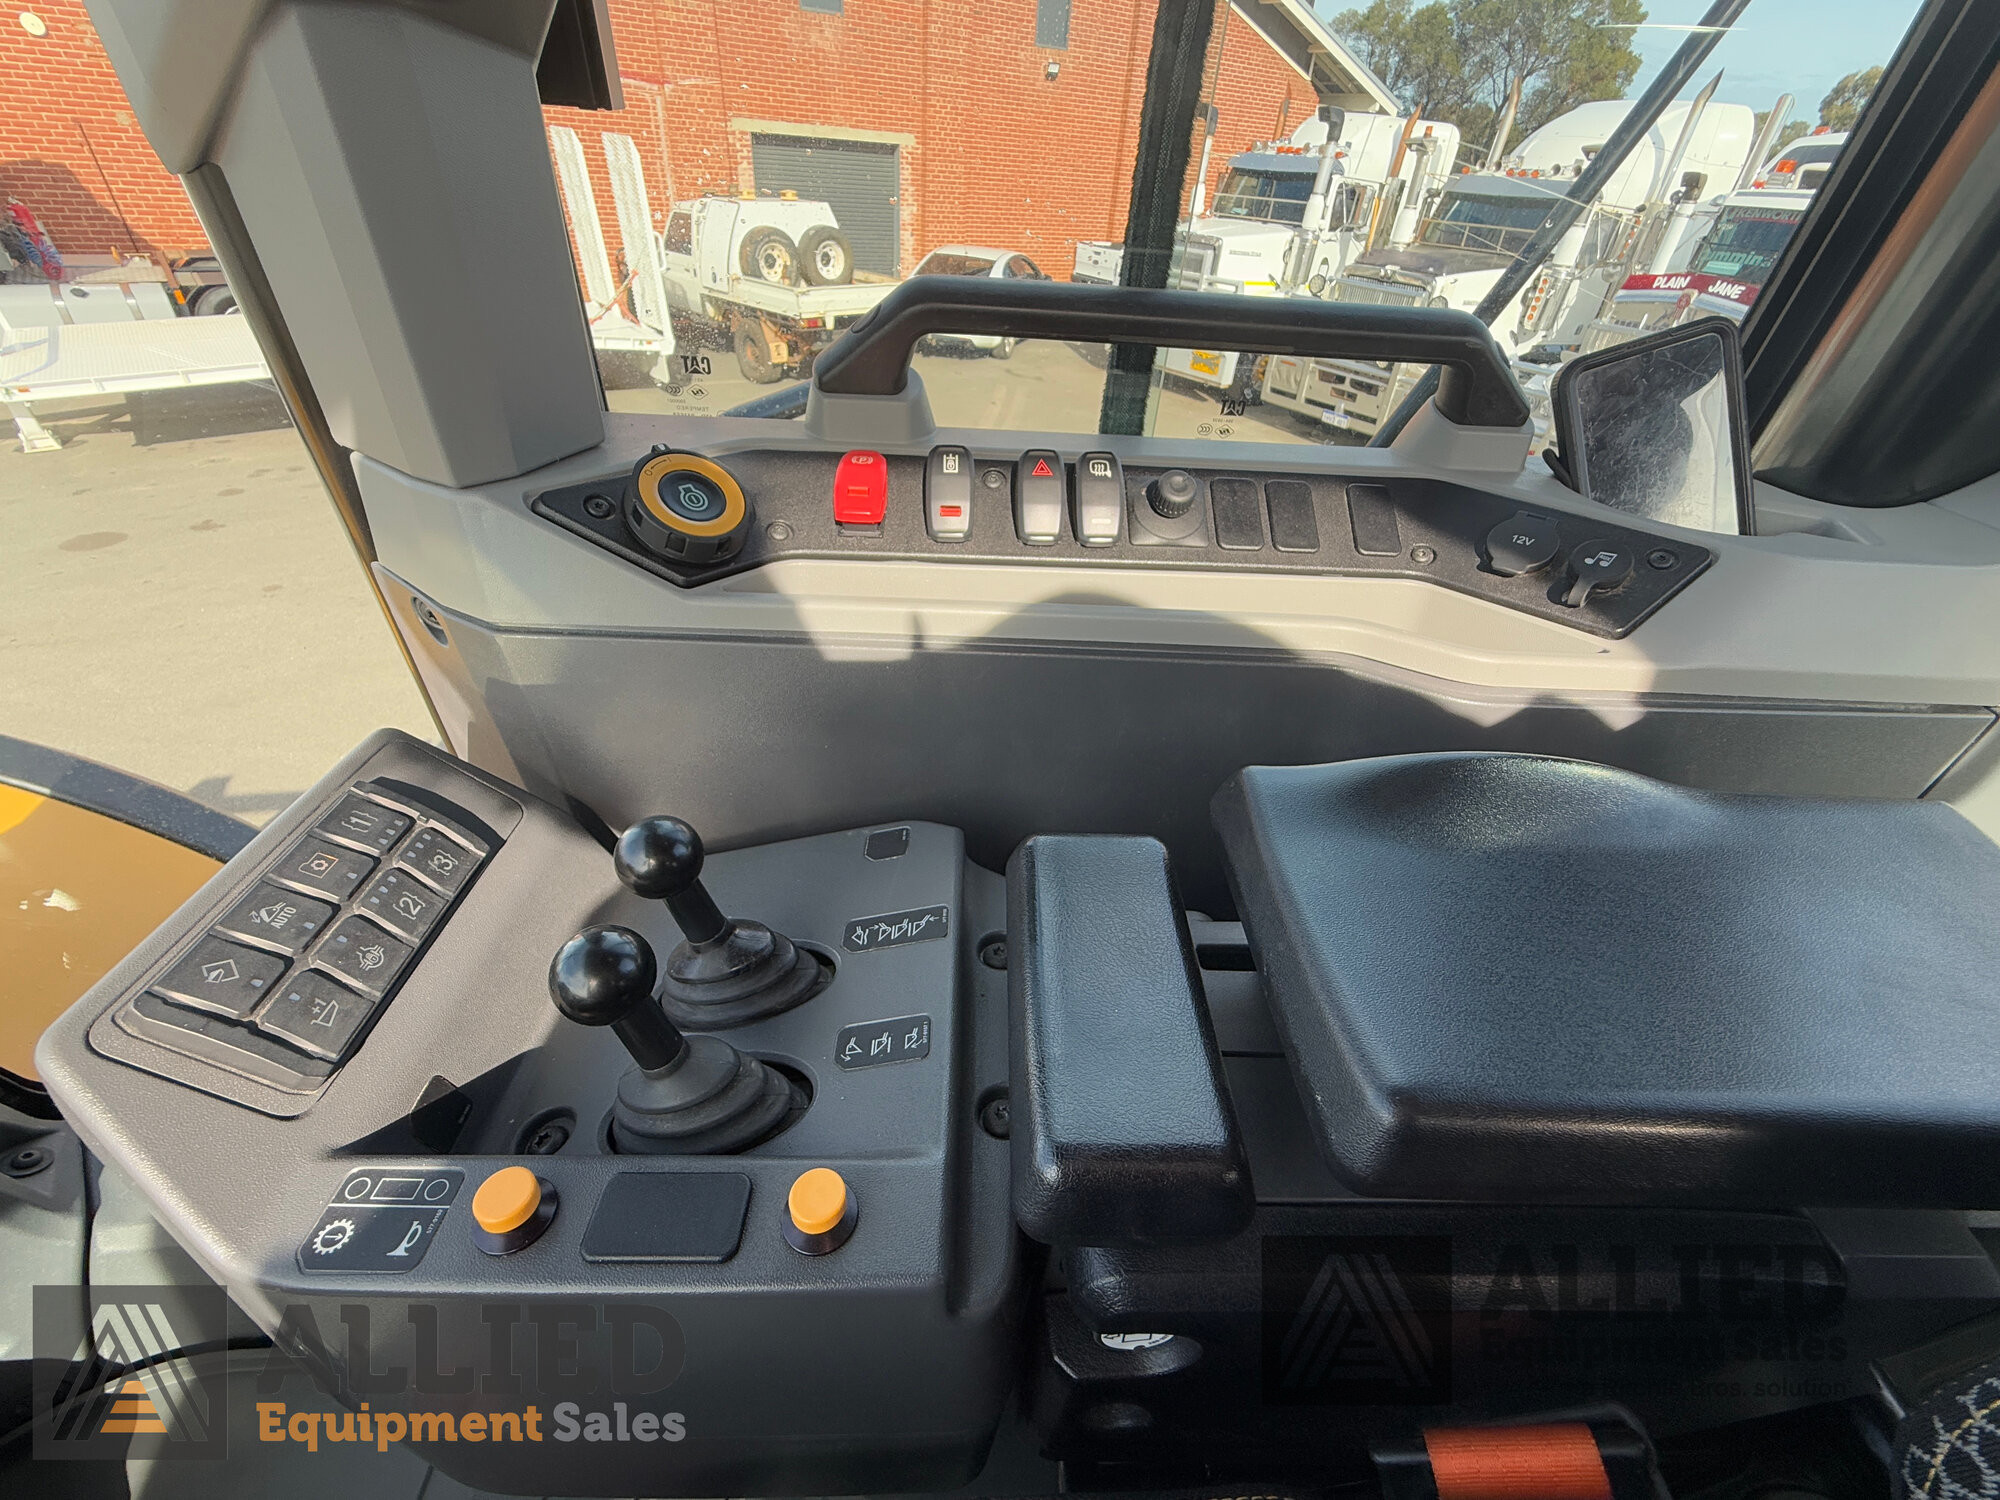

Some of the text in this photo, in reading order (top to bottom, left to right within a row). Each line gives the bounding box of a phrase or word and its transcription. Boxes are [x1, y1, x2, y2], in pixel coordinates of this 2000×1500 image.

[1653, 276, 1746, 299] PLAIN JANE
[1512, 534, 1535, 546] 12V
[270, 906, 297, 929] AUTO
